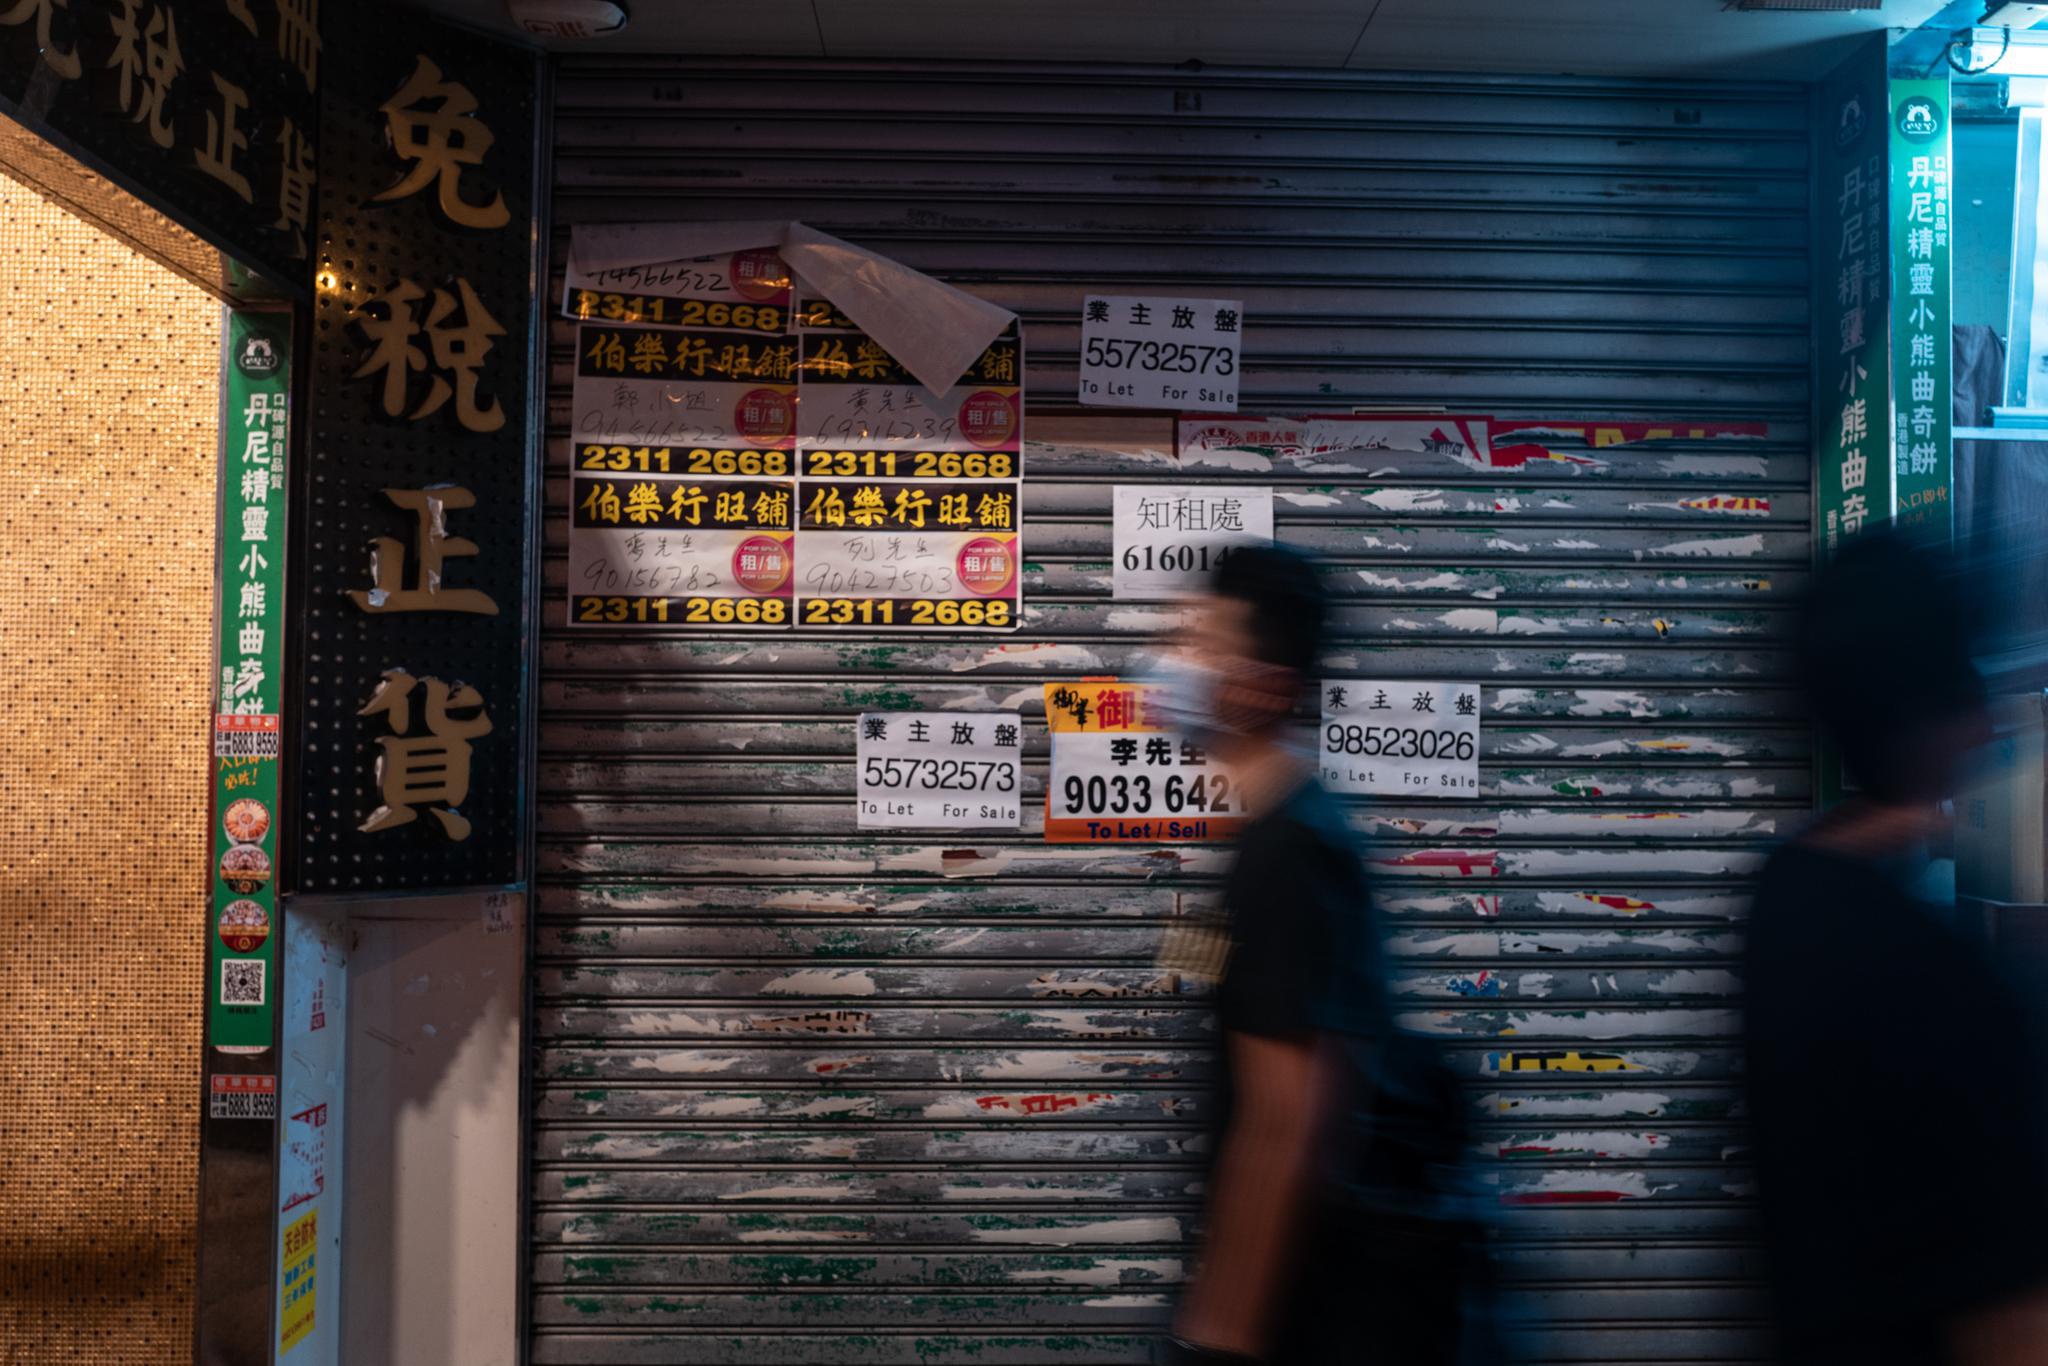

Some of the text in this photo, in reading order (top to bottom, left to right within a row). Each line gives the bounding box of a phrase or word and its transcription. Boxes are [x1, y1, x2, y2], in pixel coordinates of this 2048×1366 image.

[576, 290, 780, 331] 2311 2668
[1086, 300, 1239, 333] 業主放盤
[1906, 156, 1938, 475] 丹尼精靈小熊曲奇餅
[808, 338, 1014, 382] 伯樂舖
[1085, 337, 1234, 376] 55732573
[1081, 379, 1235, 404] To Let For Sale
[582, 446, 787, 475] 2311 2668
[808, 451, 1012, 478] 2311 2668
[580, 482, 790, 526] 伯樂行旺舖
[804, 486, 1012, 528] 伯樂行旺舖
[1136, 496, 1244, 532] 知租處
[806, 562, 954, 597] 90427503
[579, 598, 785, 624] 2311 2668
[806, 599, 1010, 626] 2311 2668
[1326, 686, 1477, 716] 業主放盤
[864, 718, 1018, 747] 業主放盤
[1326, 724, 1474, 760] 98523026
[1110, 737, 1208, 767] 李先生
[864, 757, 1014, 792] 55732573
[1321, 767, 1476, 788] To Let For Sale
[860, 800, 1017, 819] To Let For Sale
[1064, 775, 1152, 814] 9033
[1087, 822, 1112, 839] To
[1118, 822, 1150, 839] Let
[1168, 821, 1207, 838] Sell
